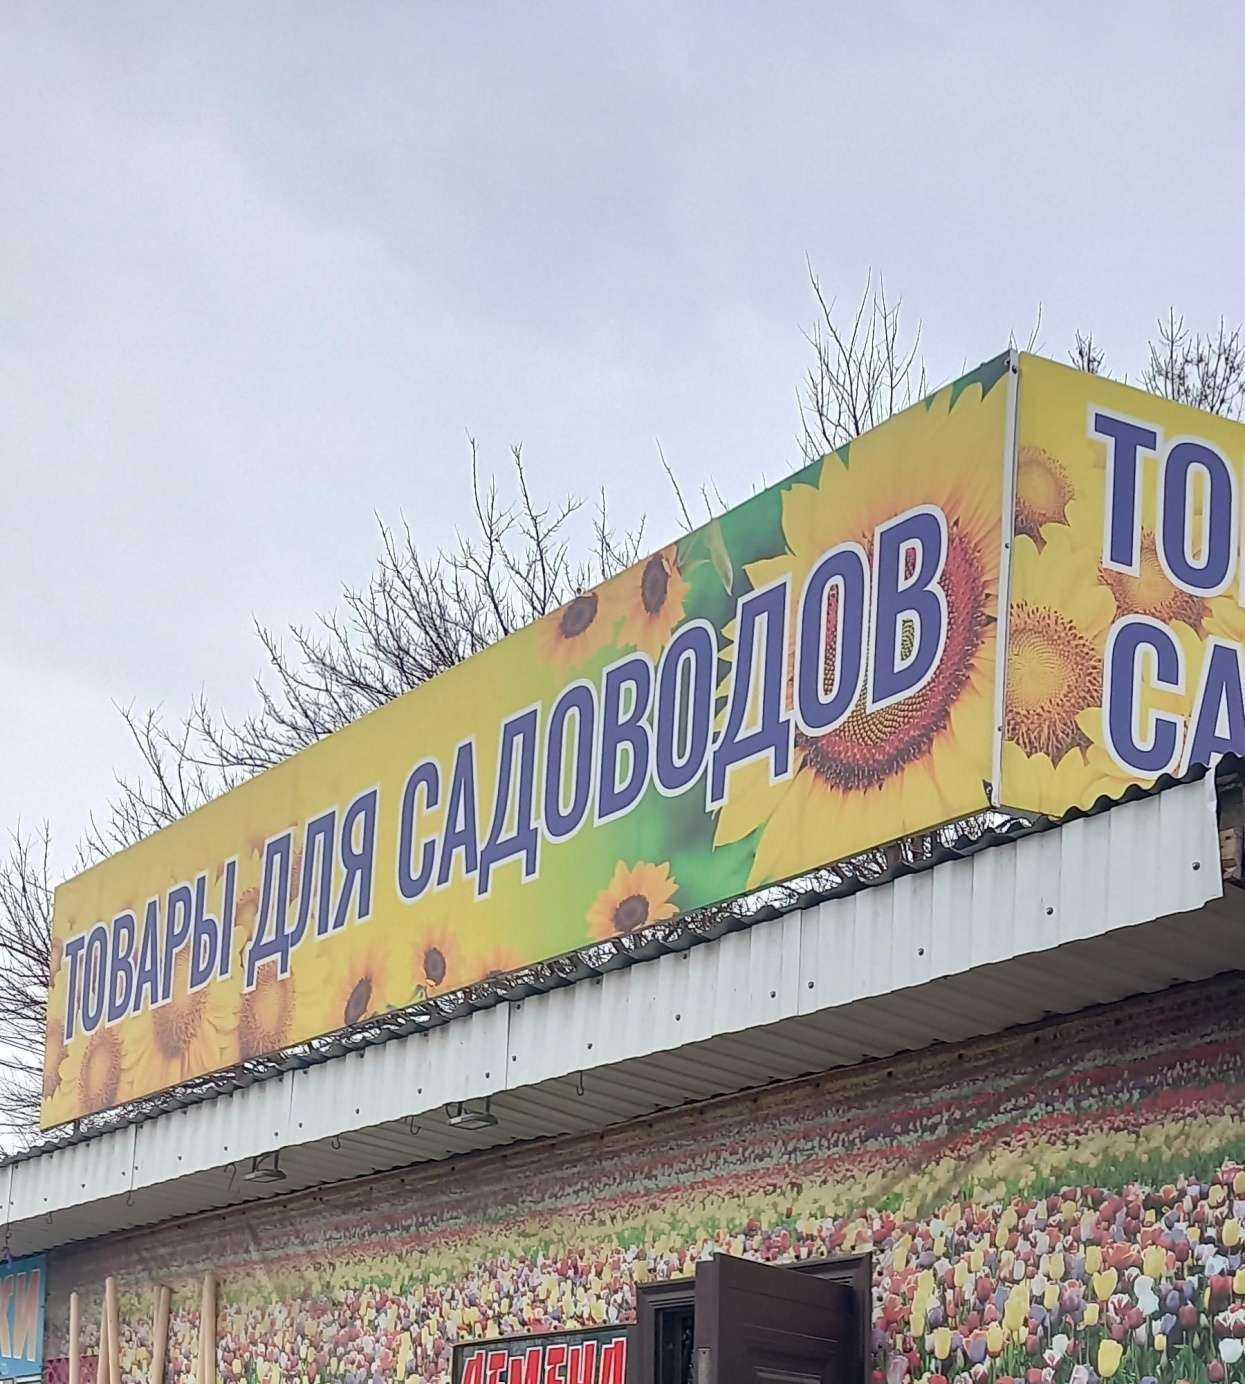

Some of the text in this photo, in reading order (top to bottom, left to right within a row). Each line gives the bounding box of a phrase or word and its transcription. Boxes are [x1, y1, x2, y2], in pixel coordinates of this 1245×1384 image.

[1090, 406, 1245, 600] ТО
[62, 504, 953, 1042] ТОВАРЫ ДЛЯ САДОВОДОВ
